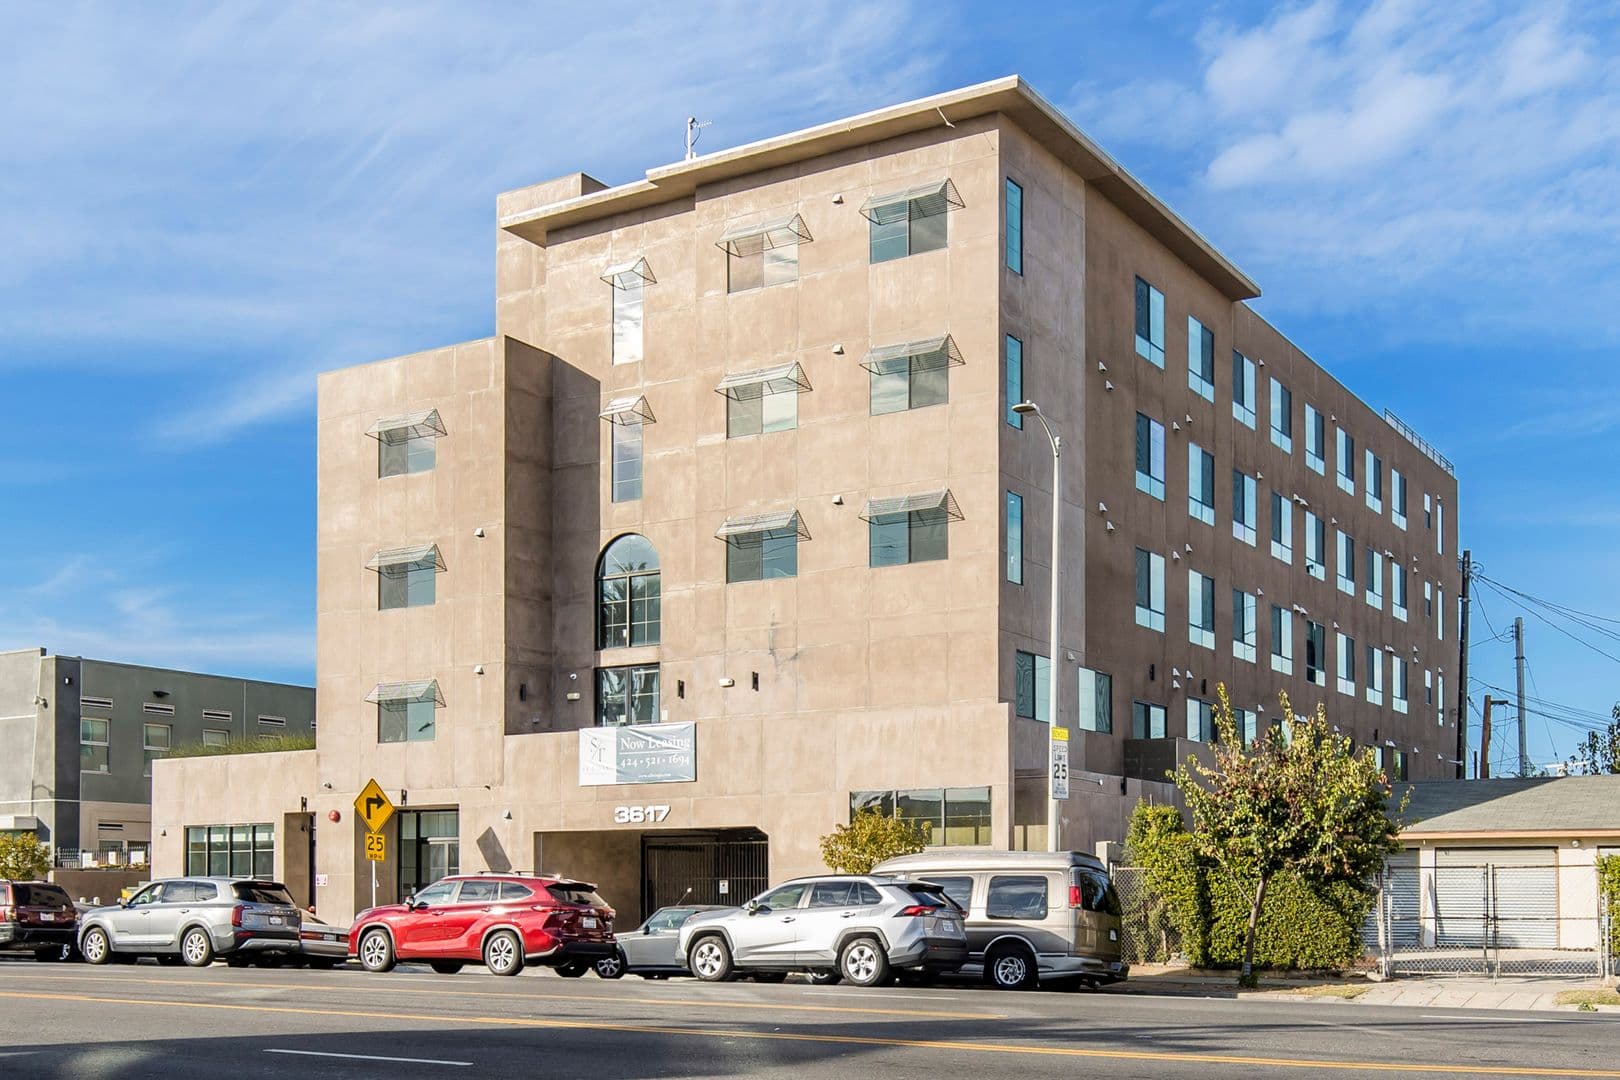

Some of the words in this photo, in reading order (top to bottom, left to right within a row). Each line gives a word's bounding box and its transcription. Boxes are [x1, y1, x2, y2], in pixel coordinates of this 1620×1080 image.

[620, 737, 645, 750] Now
[1053, 763, 1067, 779] 25
[614, 804, 671, 823] 3617
[367, 835, 384, 852] 25
